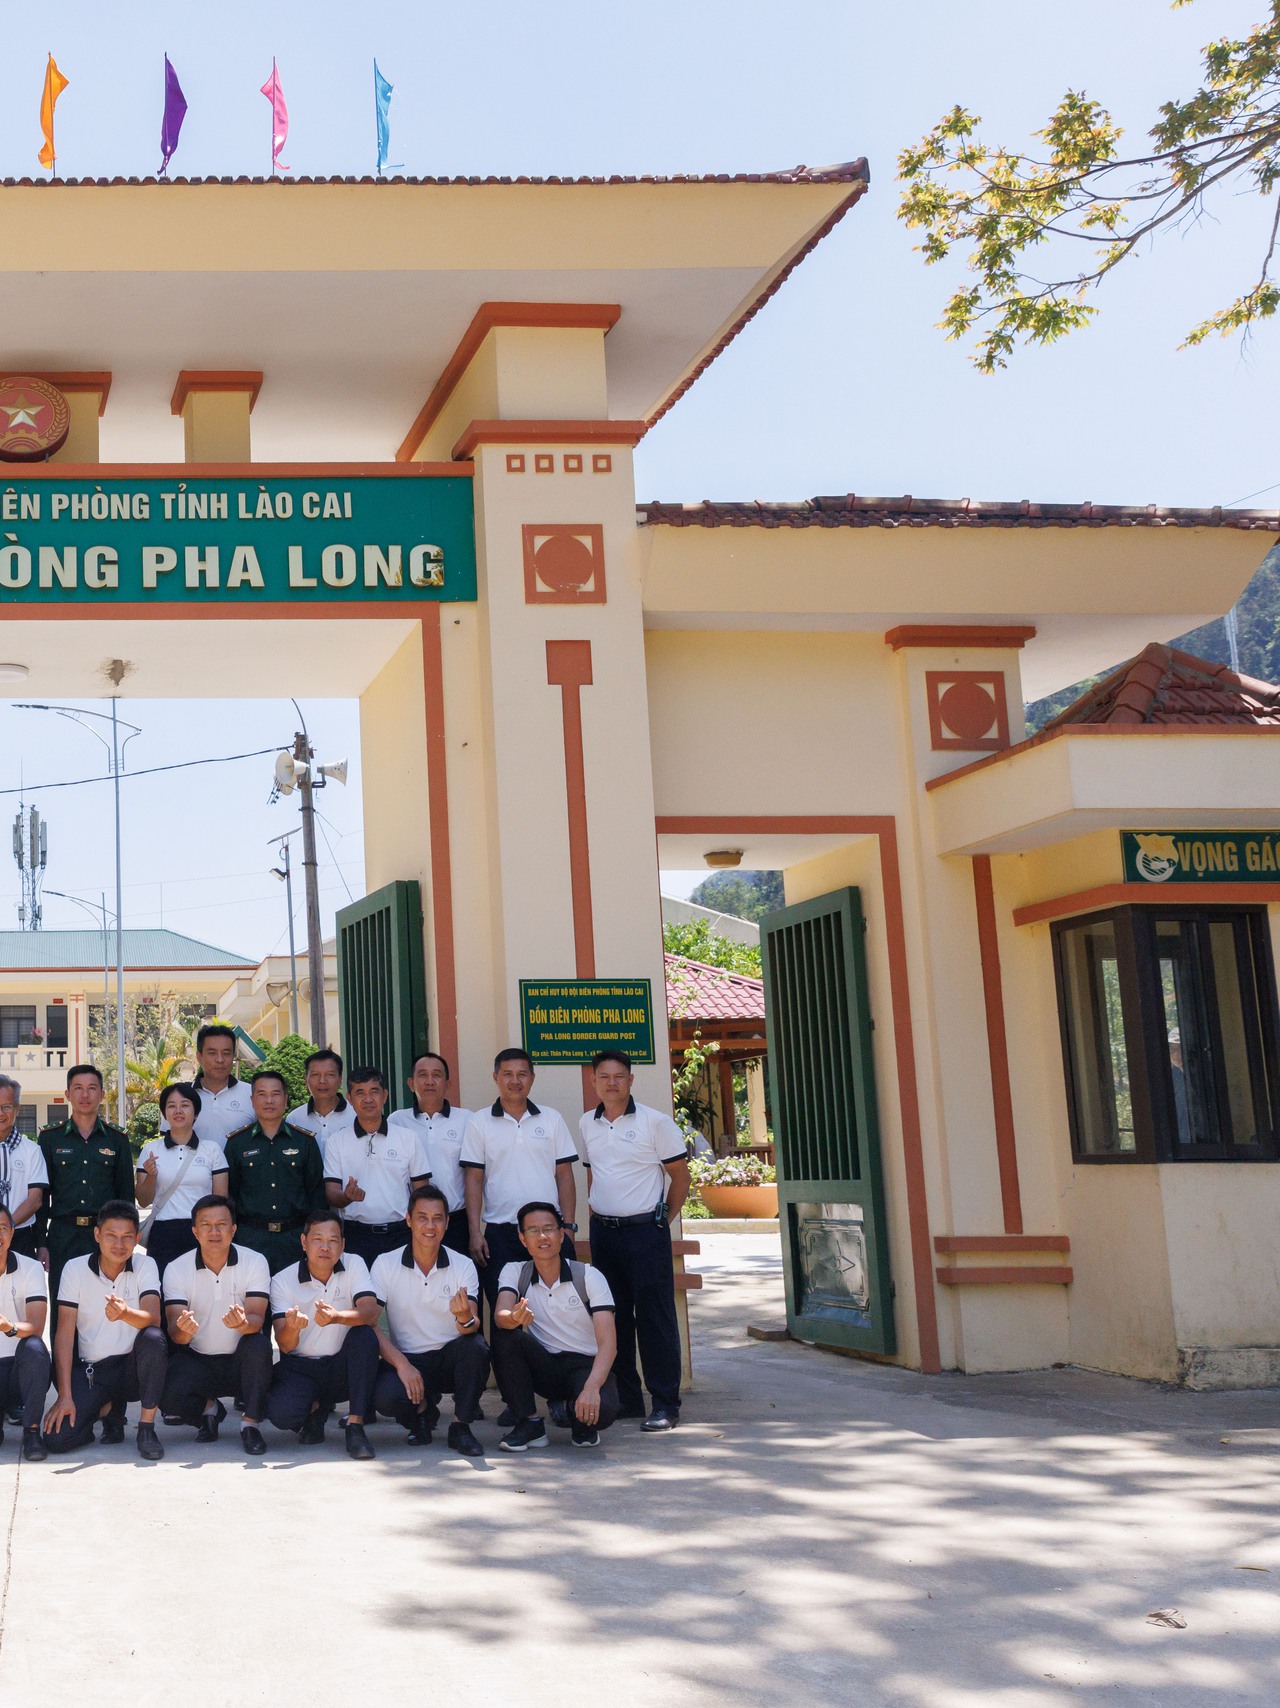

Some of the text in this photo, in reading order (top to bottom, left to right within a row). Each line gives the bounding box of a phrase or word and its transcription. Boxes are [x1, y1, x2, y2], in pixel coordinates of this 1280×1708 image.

[51, 485, 150, 521] PHÒNG
[160, 483, 228, 520] TỈNH
[238, 485, 294, 520] LÀO
[302, 491, 353, 520] CAI
[142, 545, 266, 589] PHA
[288, 543, 445, 589] LONG
[1177, 841, 1239, 877] VỌNG
[528, 988, 539, 996] BAN
[529, 1004, 645, 1024] ĐỒN BIÊN PHÒNG PHA LONG
